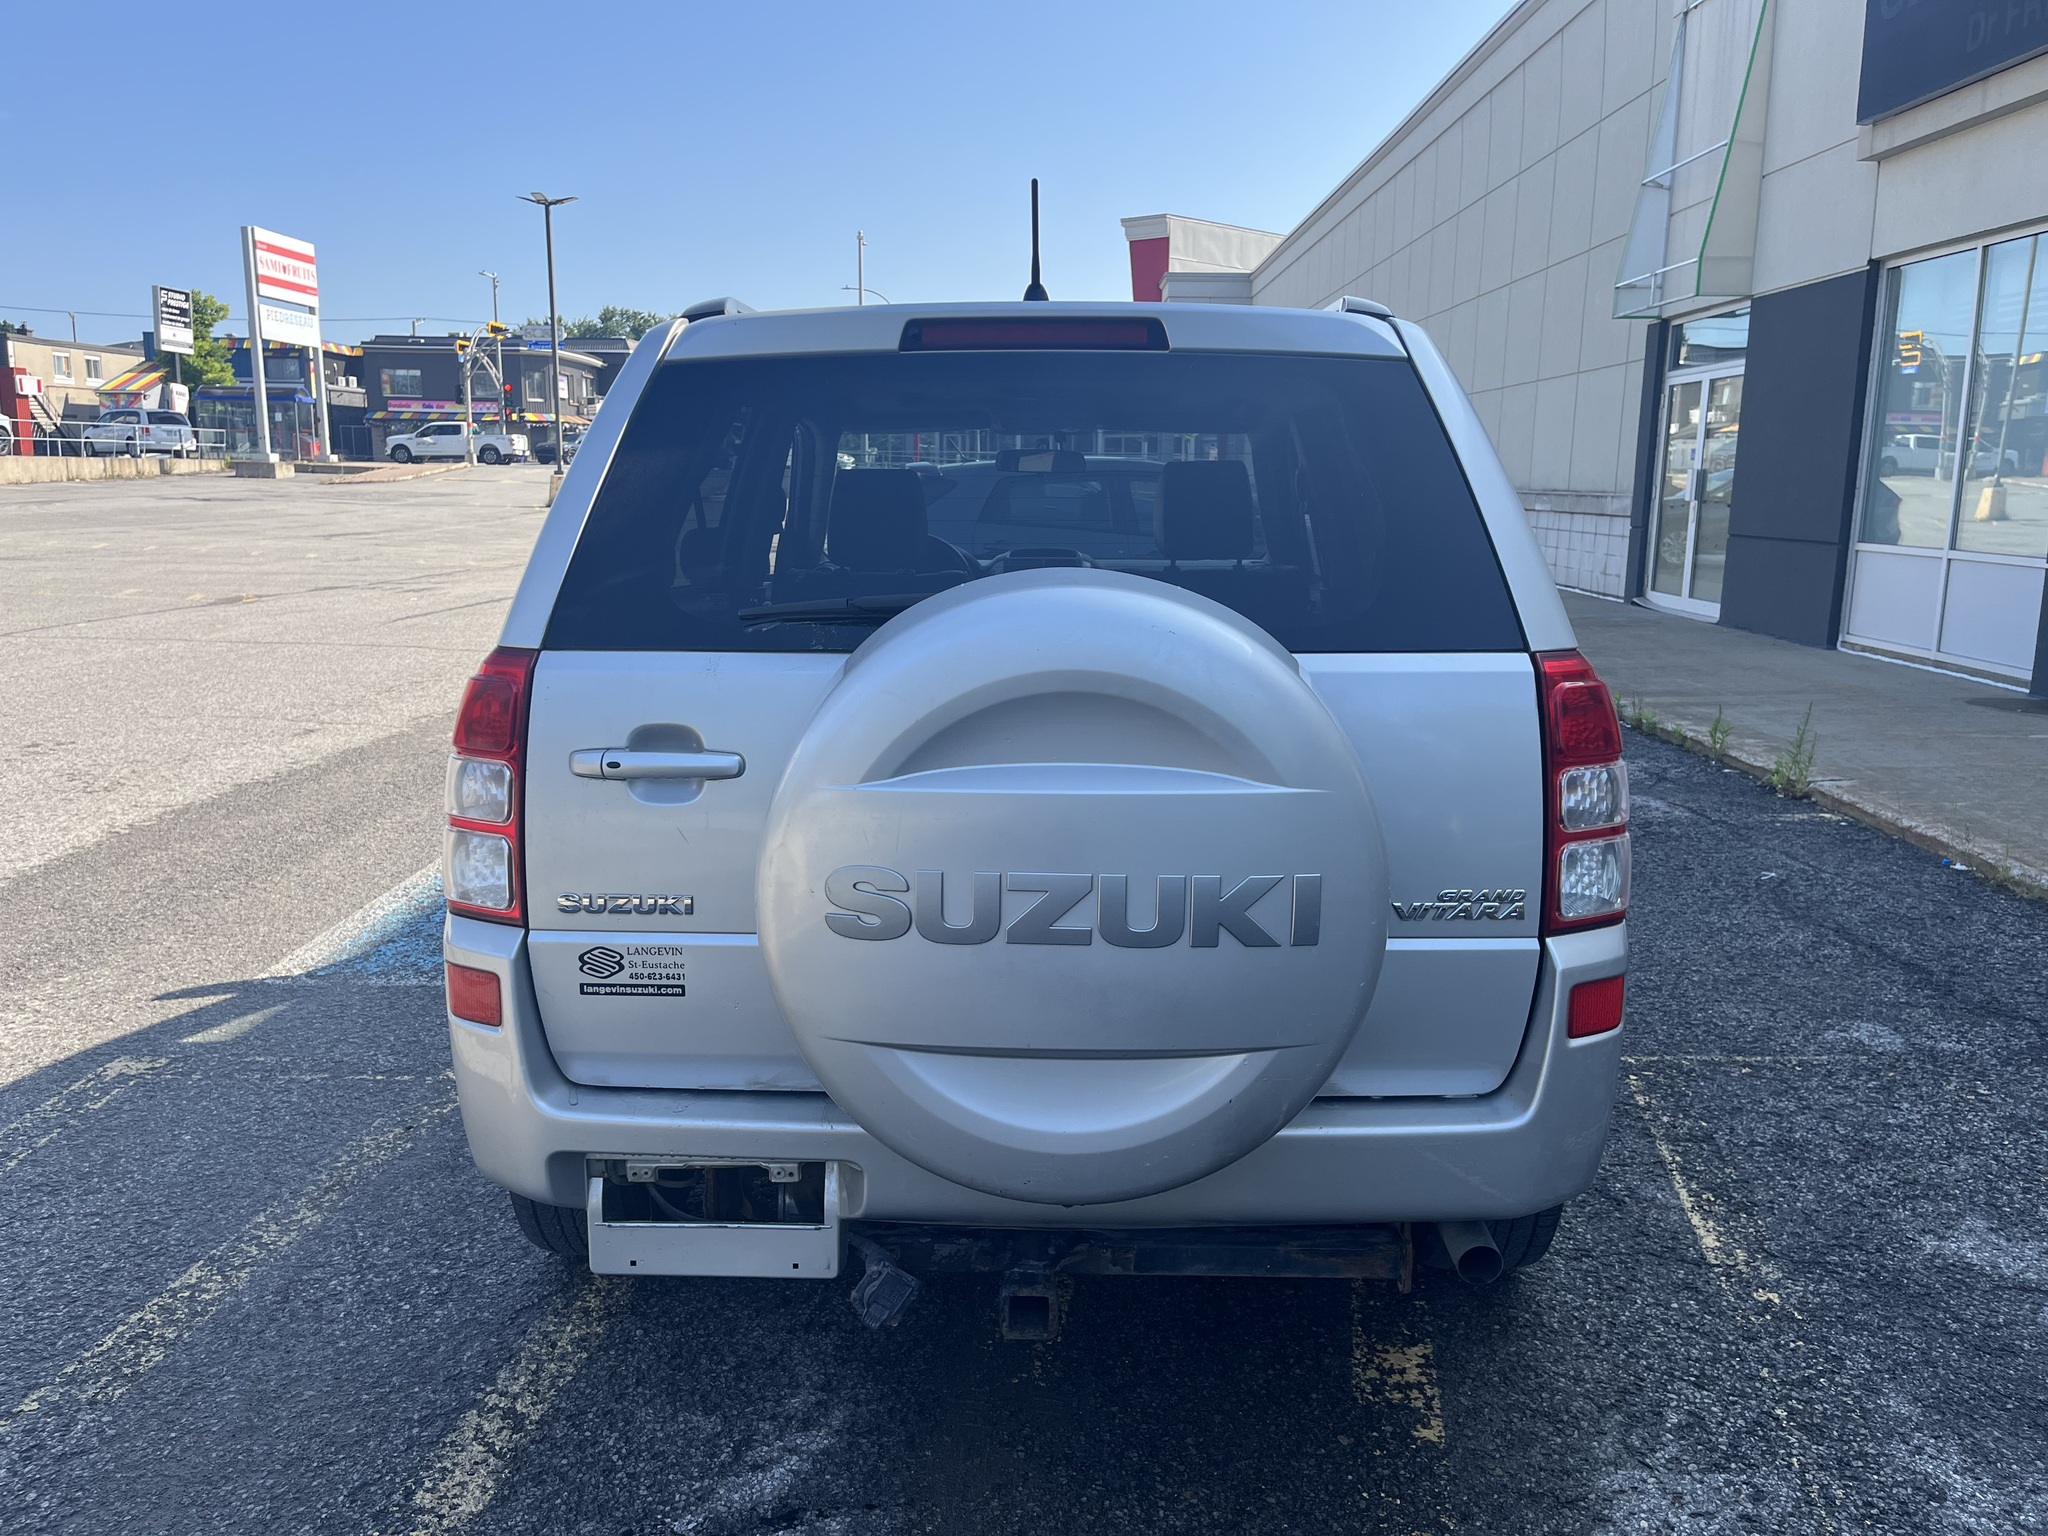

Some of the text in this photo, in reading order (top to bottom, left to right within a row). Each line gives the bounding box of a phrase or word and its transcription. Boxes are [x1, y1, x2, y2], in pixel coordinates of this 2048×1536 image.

[259, 256, 317, 283] SAMI FRUITS
[1437, 889, 1527, 903] GRAND
[556, 892, 694, 916] SUZUKI
[824, 864, 1321, 949] SUZUKI
[1391, 902, 1526, 921] VITARA
[626, 946, 683, 956] LANGEVIN
[628, 960, 685, 970] St-Eustache
[628, 972, 686, 981] 450-623-6431
[583, 984, 683, 995] langevinsuzuki.com
